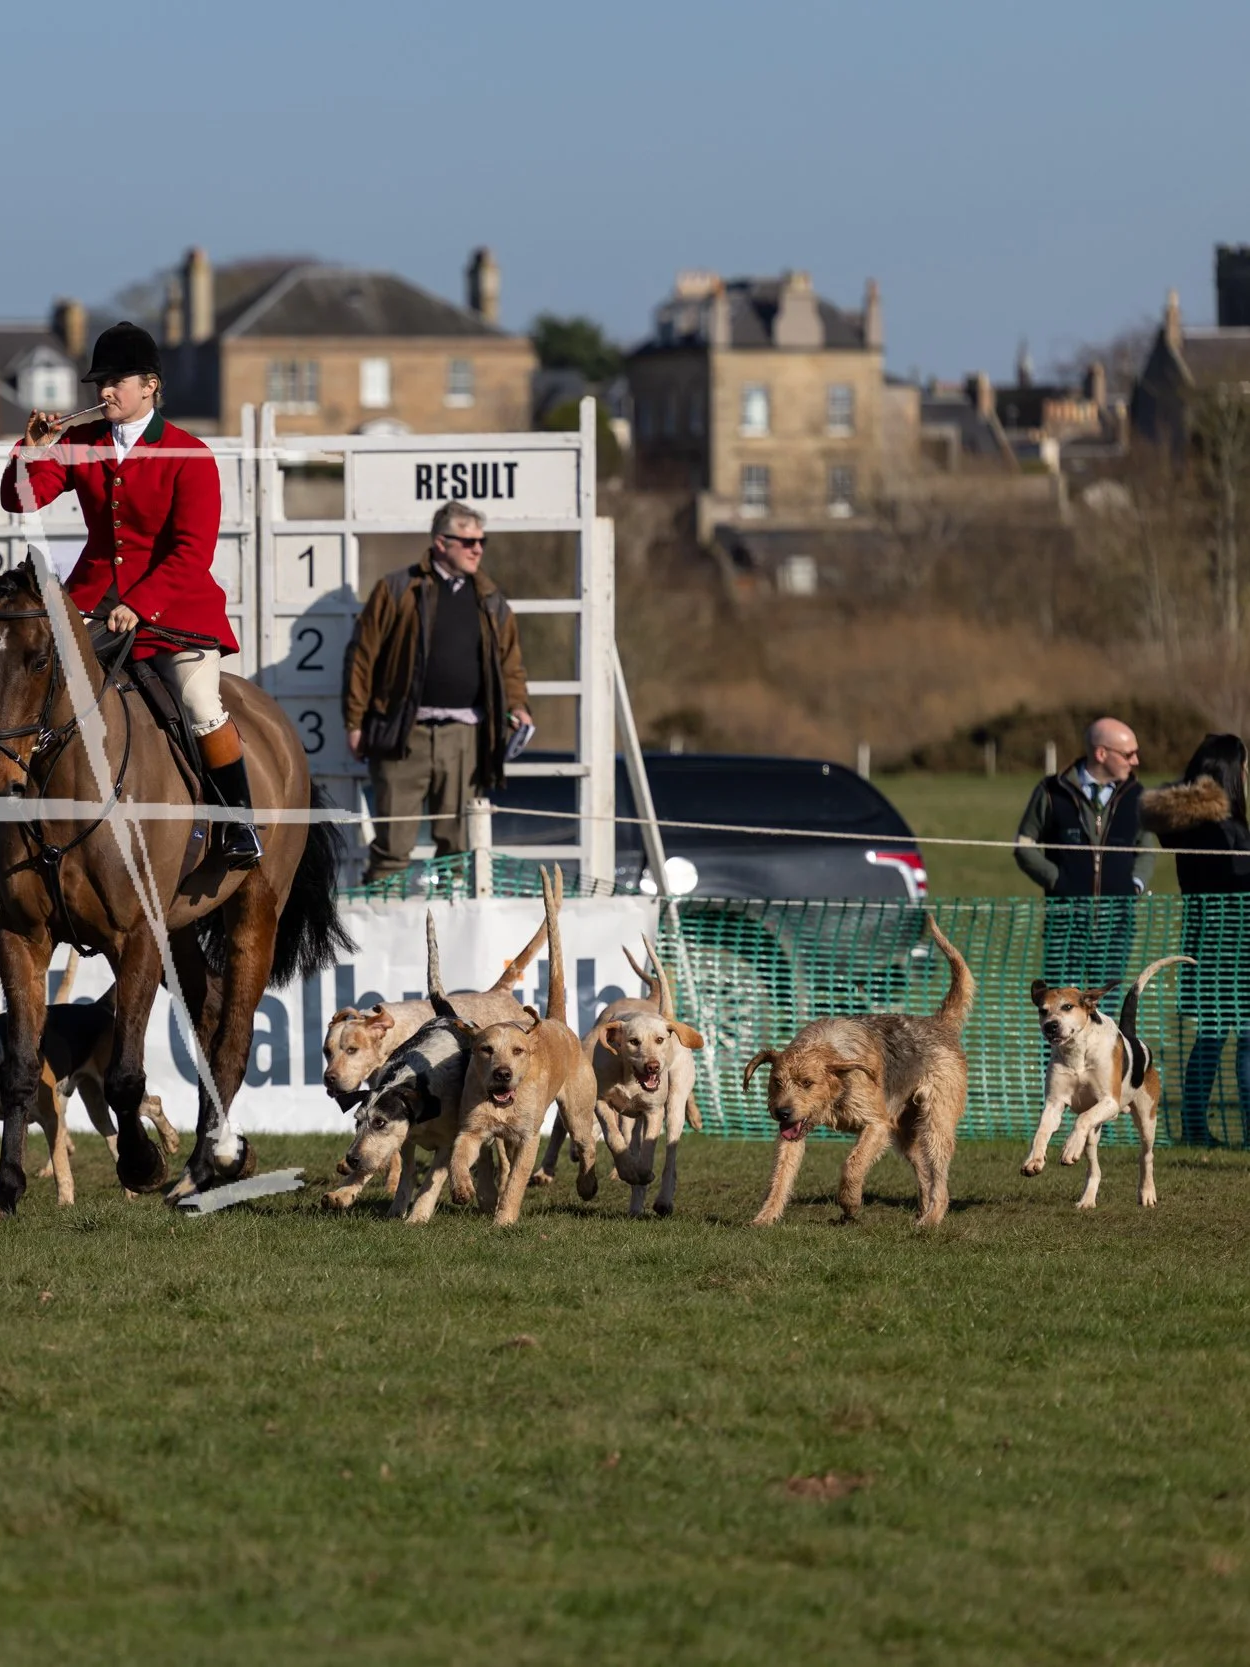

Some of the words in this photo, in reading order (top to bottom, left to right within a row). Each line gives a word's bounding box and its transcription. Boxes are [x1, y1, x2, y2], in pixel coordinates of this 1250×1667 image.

[416, 462, 518, 500] RESULT
[299, 545, 314, 588] 1
[296, 627, 324, 671] 2
[299, 710, 326, 755] 3
